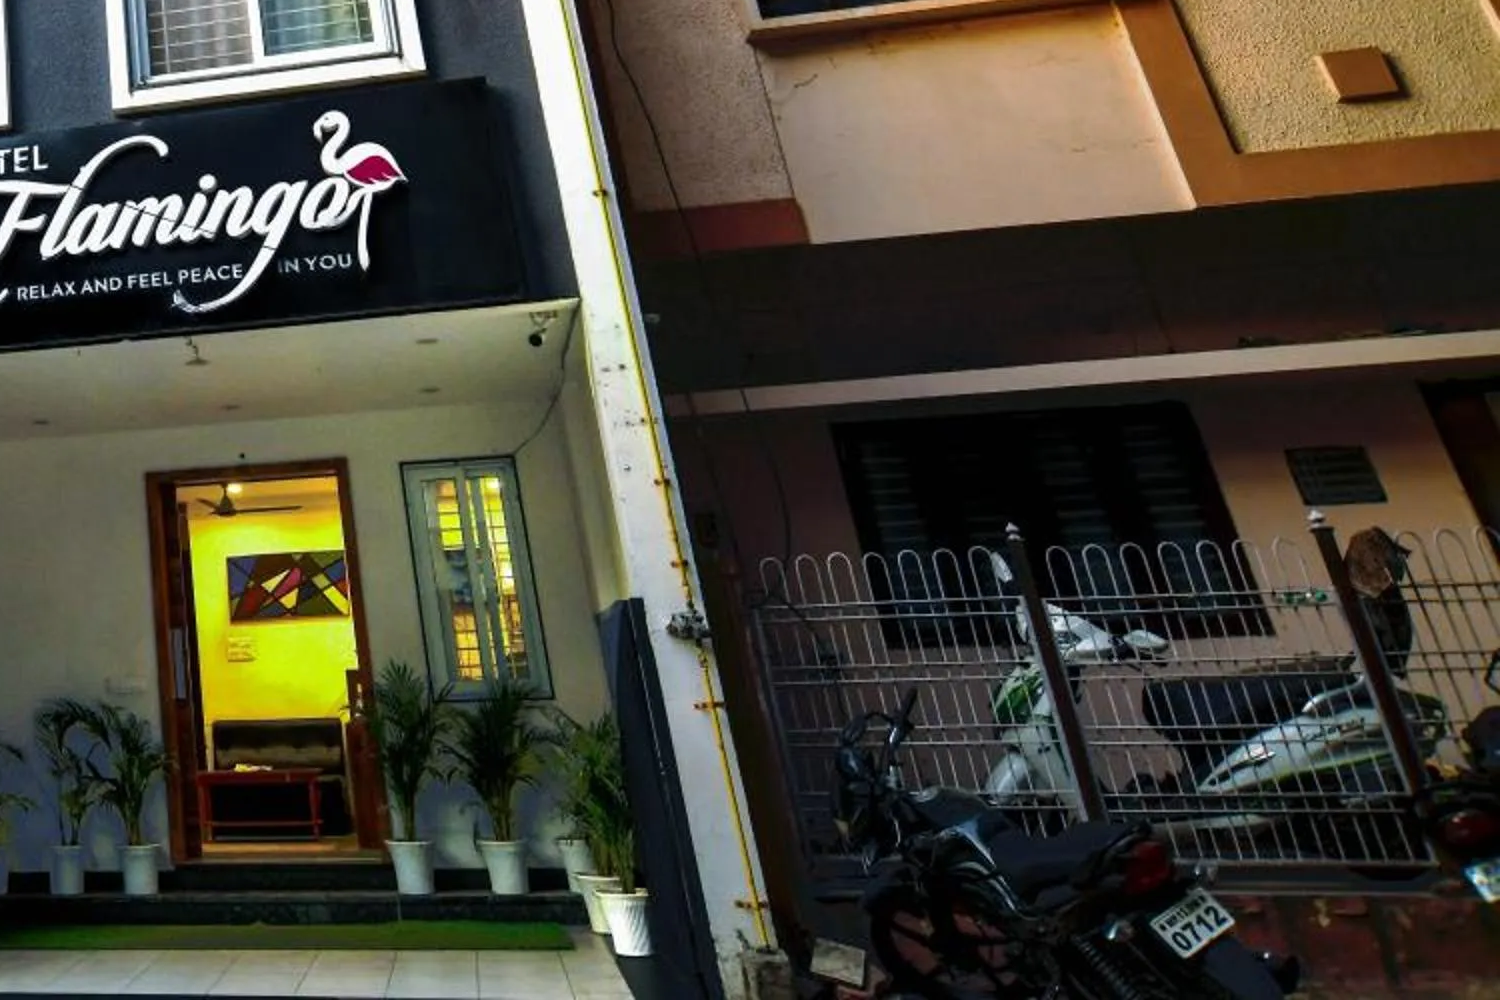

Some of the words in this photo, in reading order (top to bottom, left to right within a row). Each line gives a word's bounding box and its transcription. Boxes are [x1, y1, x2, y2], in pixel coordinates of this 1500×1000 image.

[16, 283, 77, 301] RELAX
[81, 278, 122, 295] AND
[127, 271, 173, 291] FEEL
[177, 263, 244, 284] PEACE
[278, 260, 301, 274] IN
[304, 254, 353, 271] YOU
[1171, 905, 1228, 951] 0712
